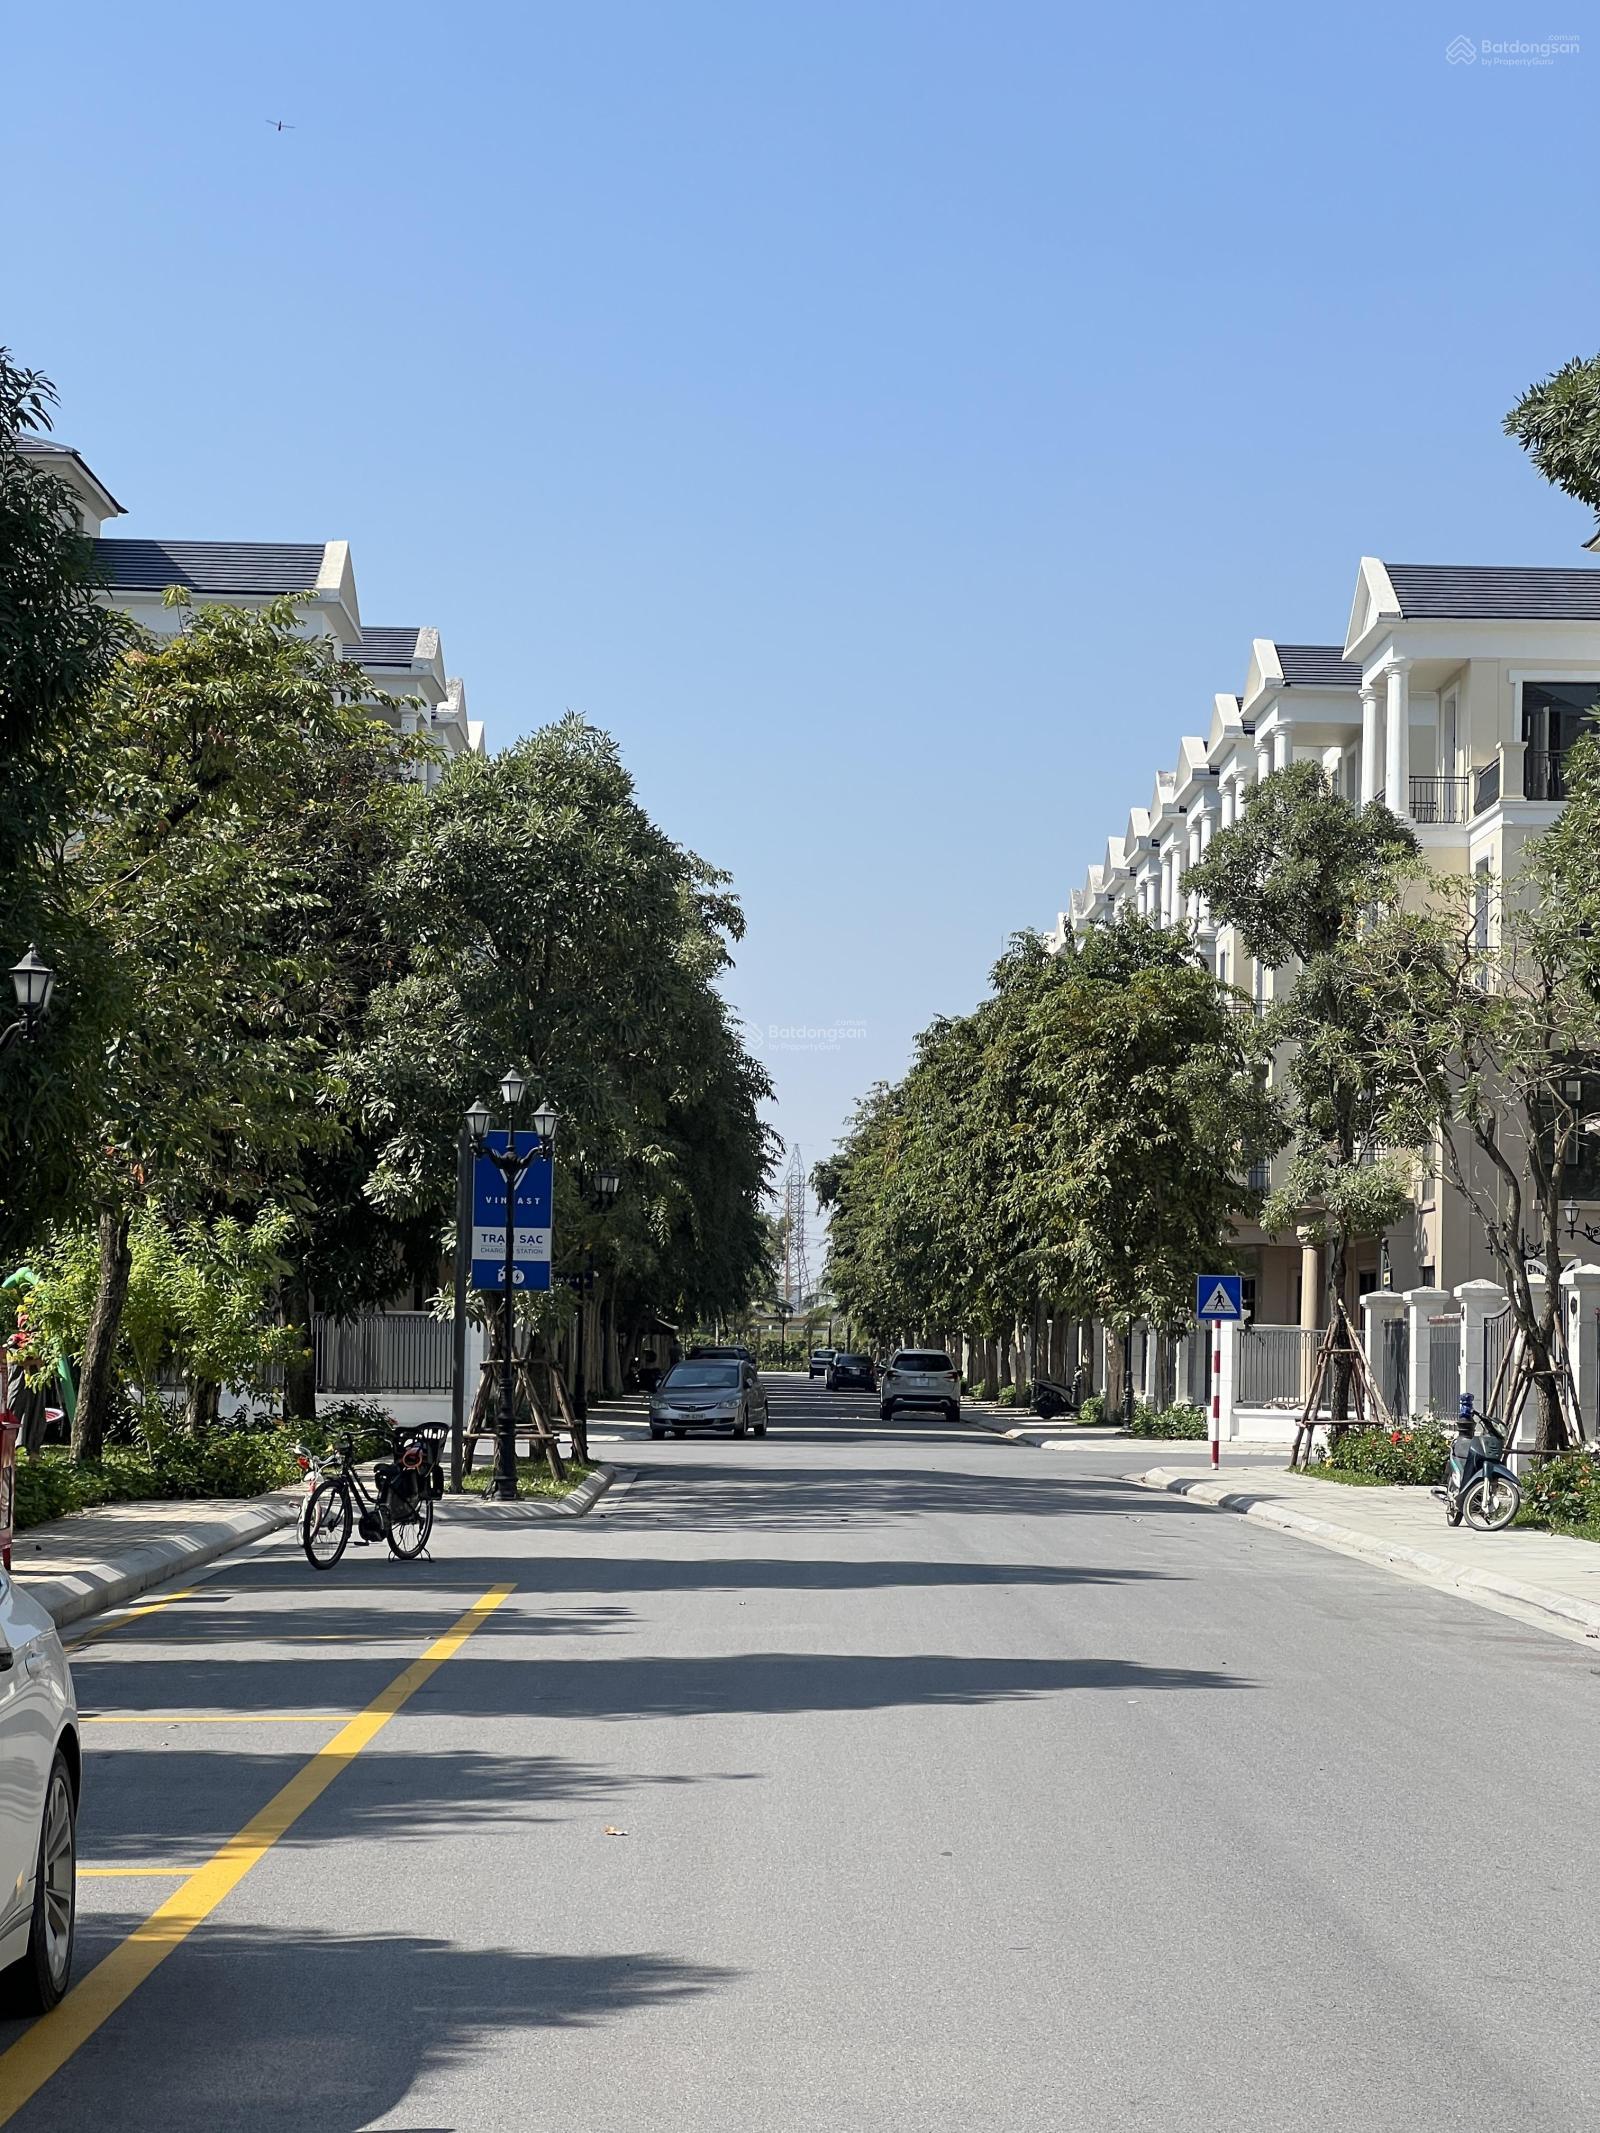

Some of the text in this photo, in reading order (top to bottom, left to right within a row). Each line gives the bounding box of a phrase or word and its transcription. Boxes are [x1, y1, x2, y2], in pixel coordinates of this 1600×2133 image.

[485, 1196, 541, 1205] VINAST
[481, 1233, 543, 1246] TRẠ SẠC
[480, 1247, 514, 1255] CHARGI
